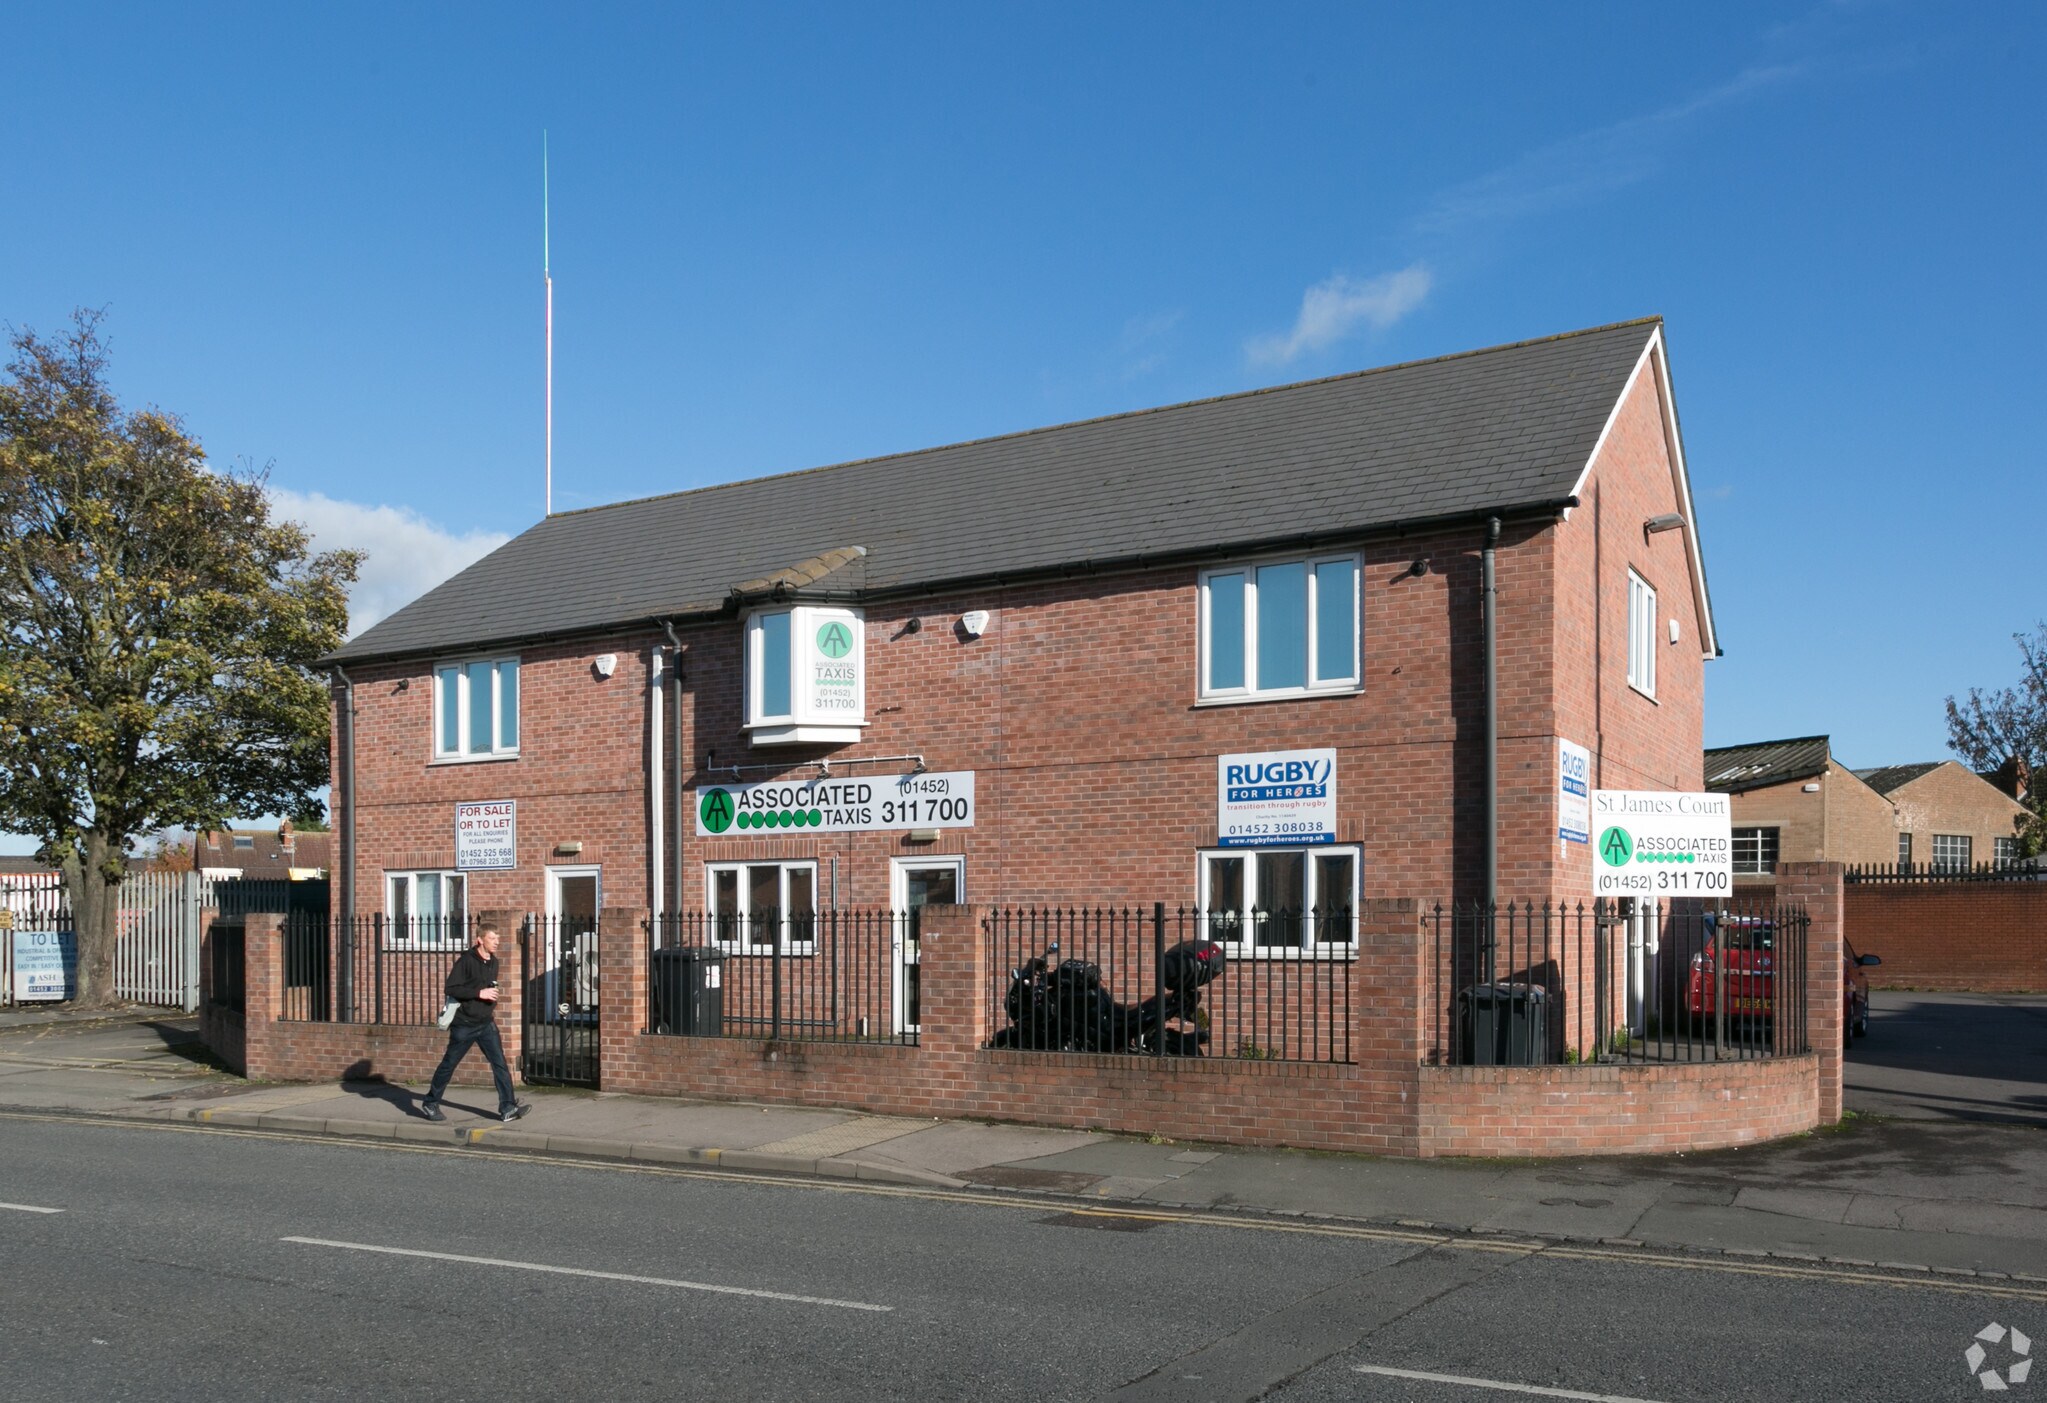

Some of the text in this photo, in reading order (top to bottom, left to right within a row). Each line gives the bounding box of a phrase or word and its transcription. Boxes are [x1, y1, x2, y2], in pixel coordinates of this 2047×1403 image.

[815, 668, 856, 679] TAXIS
[820, 689, 851, 697] (01452)
[1563, 751, 1585, 778] RUGBY
[1227, 760, 1320, 785] RUGBY
[900, 779, 950, 797] (01452)
[738, 784, 872, 809] ASSOCIATED
[1232, 790, 1258, 799] FOR
[1227, 799, 1327, 811] transition through rugby
[1597, 794, 1614, 812] St
[1620, 794, 1673, 813] James
[1678, 796, 1726, 814] Court
[460, 805, 511, 817] FOR SALE
[824, 808, 872, 826] TAXIS
[460, 819, 511, 830] OR TO LET
[1229, 822, 1323, 834] 01452 308038
[1228, 834, 1325, 845] www.rugbyforheroes.org.uk
[1636, 837, 1727, 850] ASSOCIATED
[460, 848, 512, 858] 01452 525 668
[1697, 853, 1727, 863] TAXIS
[488, 857, 500, 865] 225
[1599, 871, 1727, 891] (01452) 311 700
[30, 933, 71, 945] TO LET
